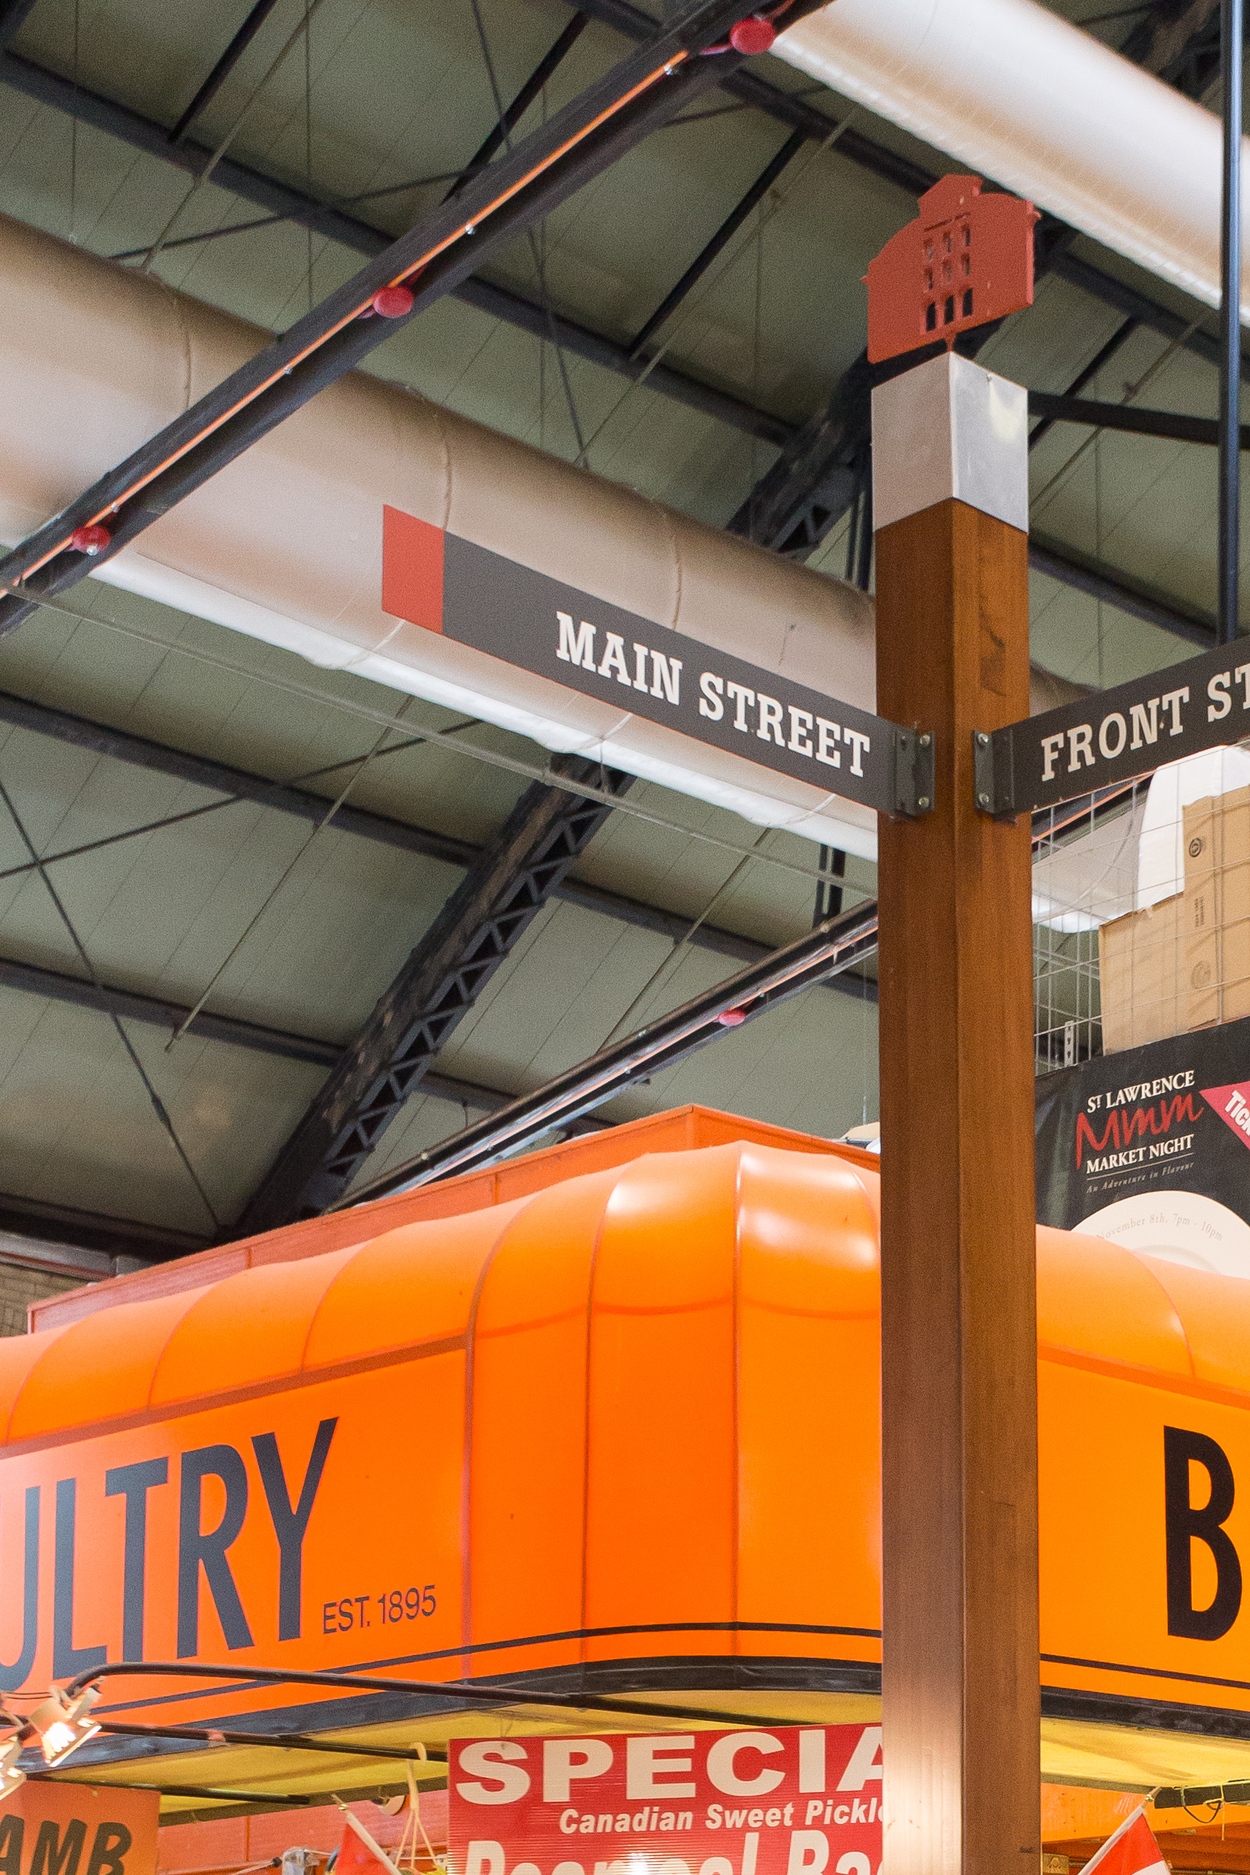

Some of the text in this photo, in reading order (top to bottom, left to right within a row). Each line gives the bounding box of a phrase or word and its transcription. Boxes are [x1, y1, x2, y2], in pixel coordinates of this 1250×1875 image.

[555, 611, 870, 777] MAIN STREET
[1040, 686, 1191, 782] FRONT
[1105, 1070, 1195, 1110] LAWRENCE
[1086, 1133, 1194, 1174] MARKET NIGHT
[1086, 1184, 1099, 1195] An
[1100, 1172, 1147, 1191] Adventure
[1161, 1161, 1194, 1177] Flavour
[323, 1584, 437, 1634] EST. 1895
[560, 1807, 693, 1835] Canadian
[705, 1801, 793, 1830] Sweet
